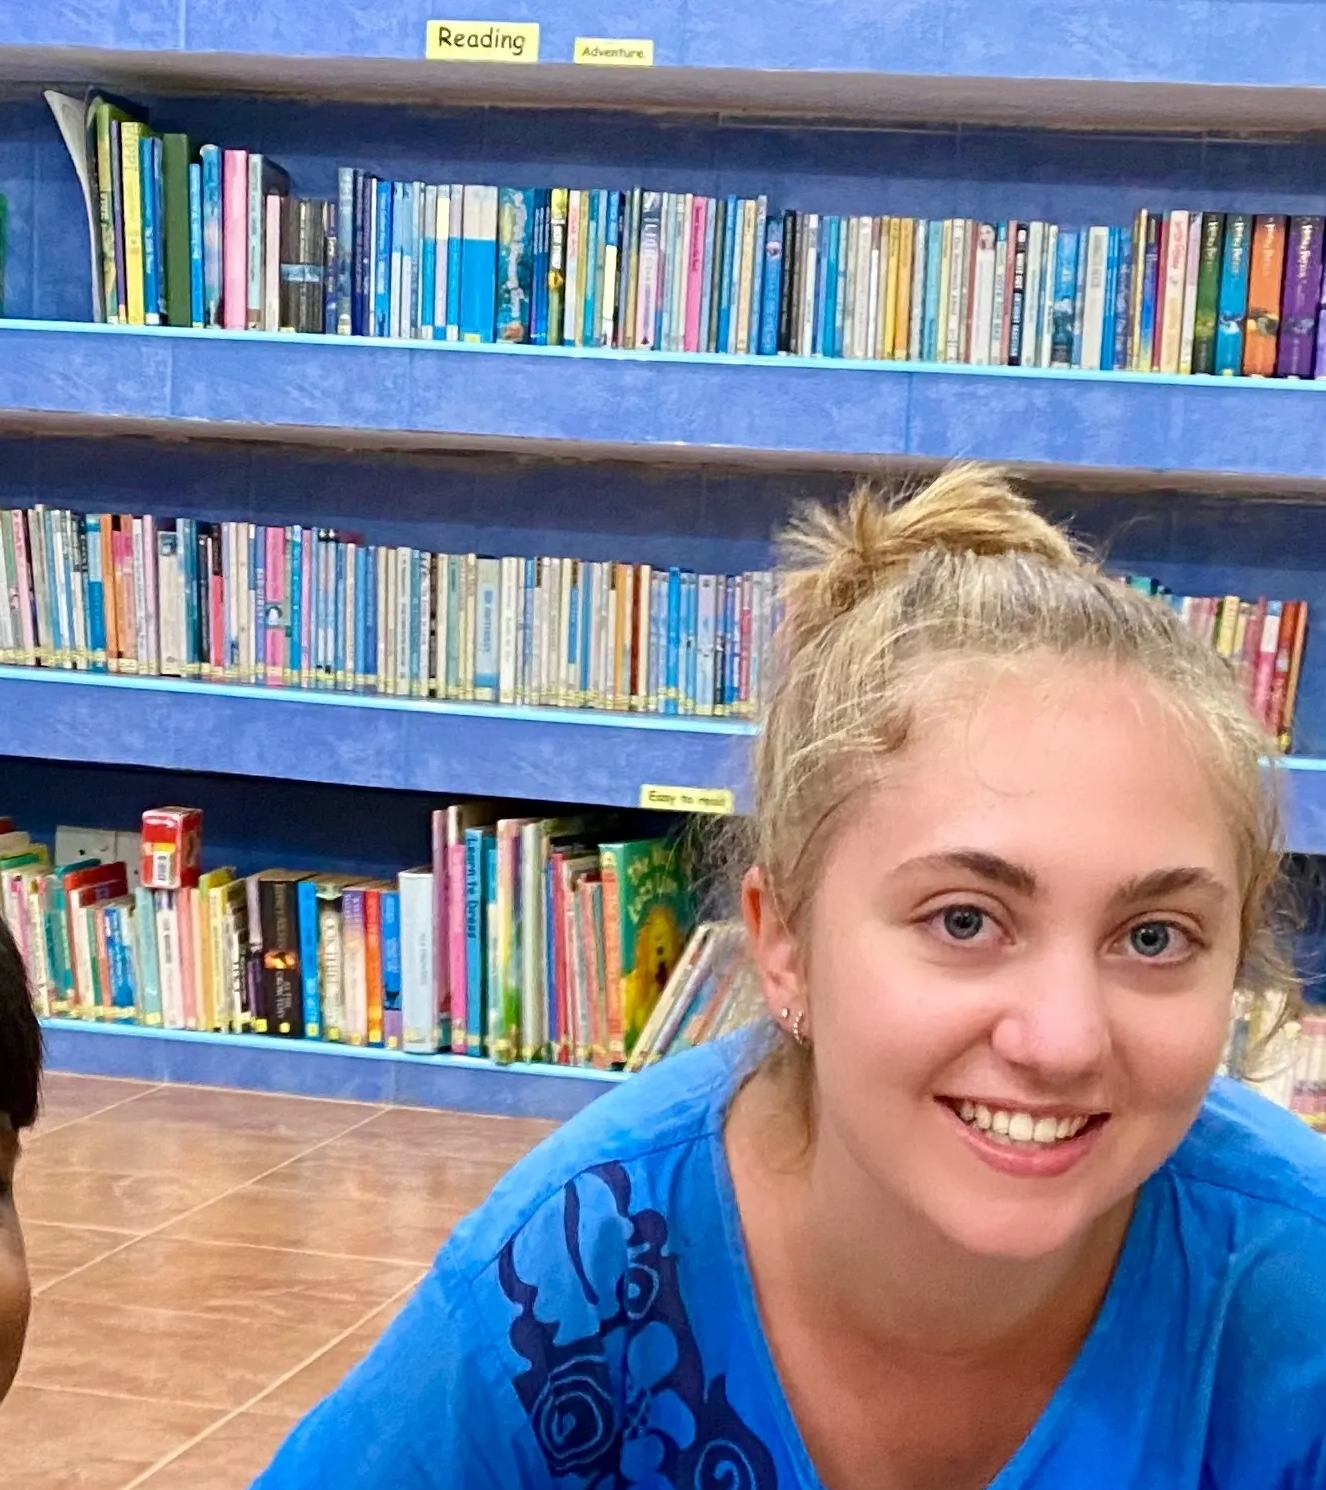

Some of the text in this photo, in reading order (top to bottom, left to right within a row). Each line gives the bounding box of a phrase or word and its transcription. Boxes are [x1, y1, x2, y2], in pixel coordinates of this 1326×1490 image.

[439, 27, 525, 55] Reading
[582, 46, 645, 60] Adventure
[648, 790, 675, 805] Easy
[681, 795, 694, 804] to
[466, 838, 480, 939] Learn to Dress
